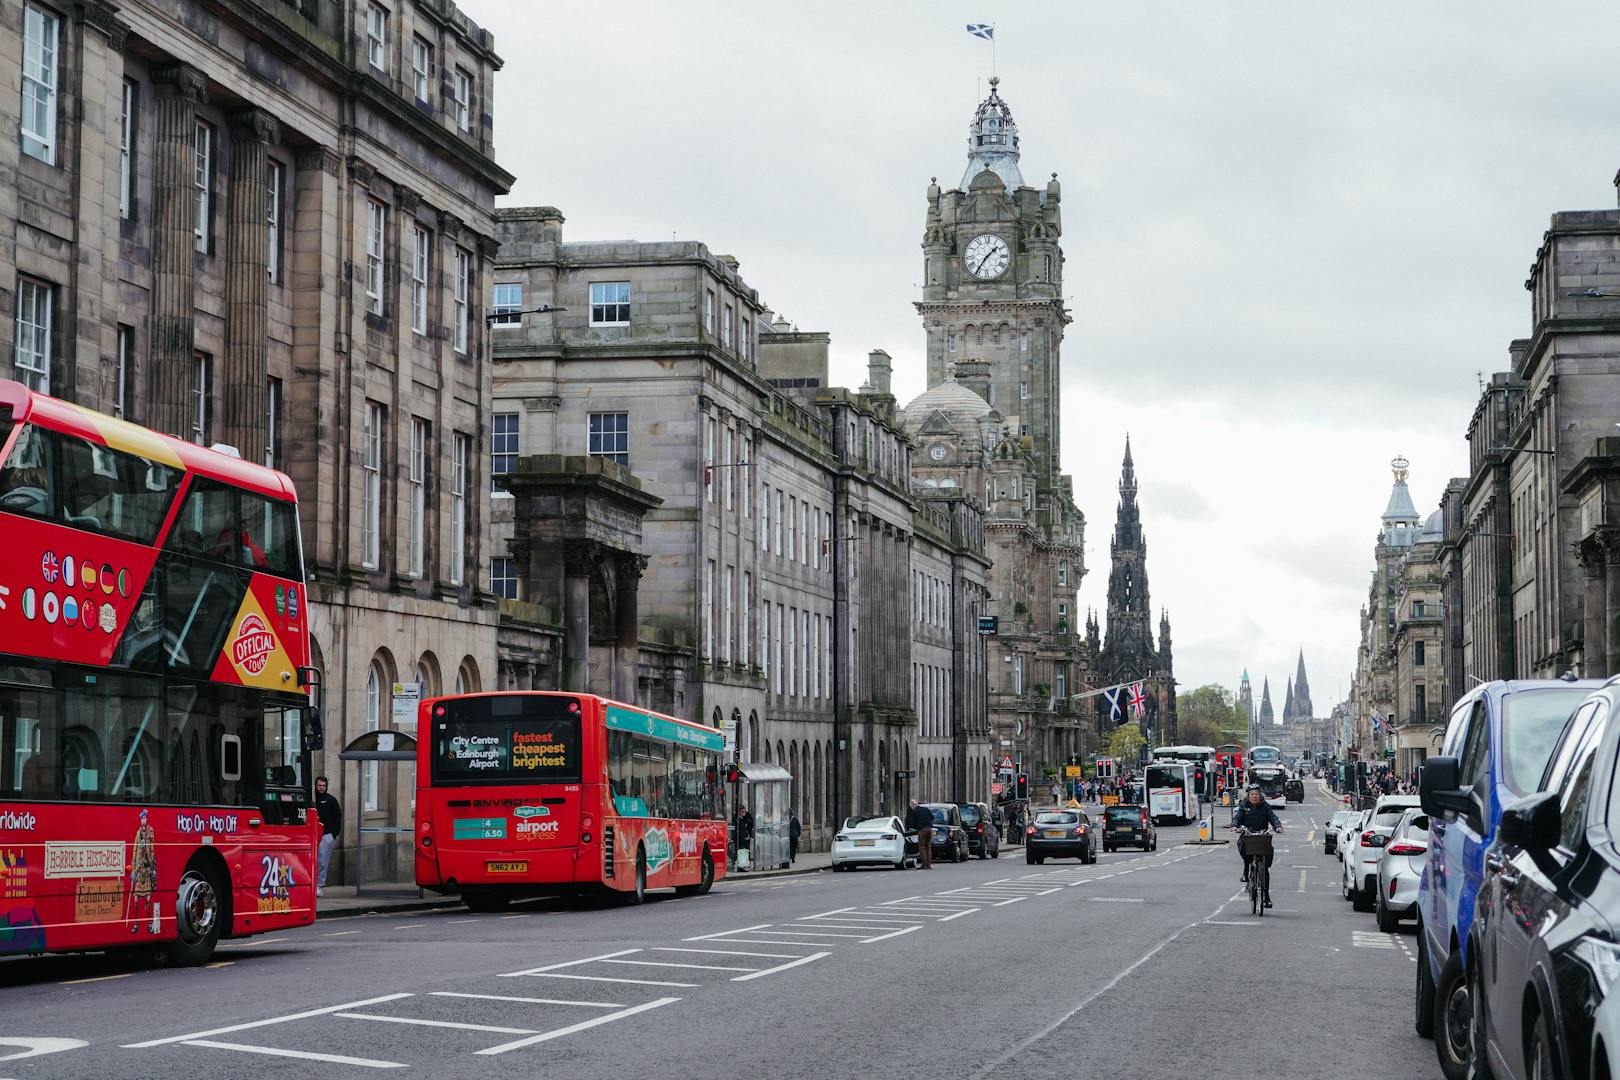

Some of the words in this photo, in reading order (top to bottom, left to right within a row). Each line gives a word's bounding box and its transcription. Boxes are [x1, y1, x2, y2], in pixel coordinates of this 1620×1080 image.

[236, 635, 274, 661] OFFICIAL
[248, 655, 267, 671] TOUR
[452, 736, 469, 746] City
[471, 736, 499, 745] Centre
[513, 732, 553, 743] fastest
[448, 751, 455, 759] &
[456, 750, 499, 761] Edinburgh
[513, 743, 566, 757] cheapest
[469, 760, 499, 770] Airport
[513, 756, 566, 770] brightest
[516, 808, 535, 817] Bright
[177, 815, 193, 832] Hop
[194, 814, 205, 832] On
[209, 816, 225, 834] Hop
[225, 815, 237, 832] Off
[516, 819, 558, 834] airport
[516, 832, 556, 841] express
[50, 850, 84, 869] HORRIBLE
[86, 849, 121, 868] HISTORIES
[490, 863, 508, 871] SN62
[511, 863, 524, 871] AYJ
[260, 856, 280, 895] 24
[78, 885, 121, 907] Edinburgh
